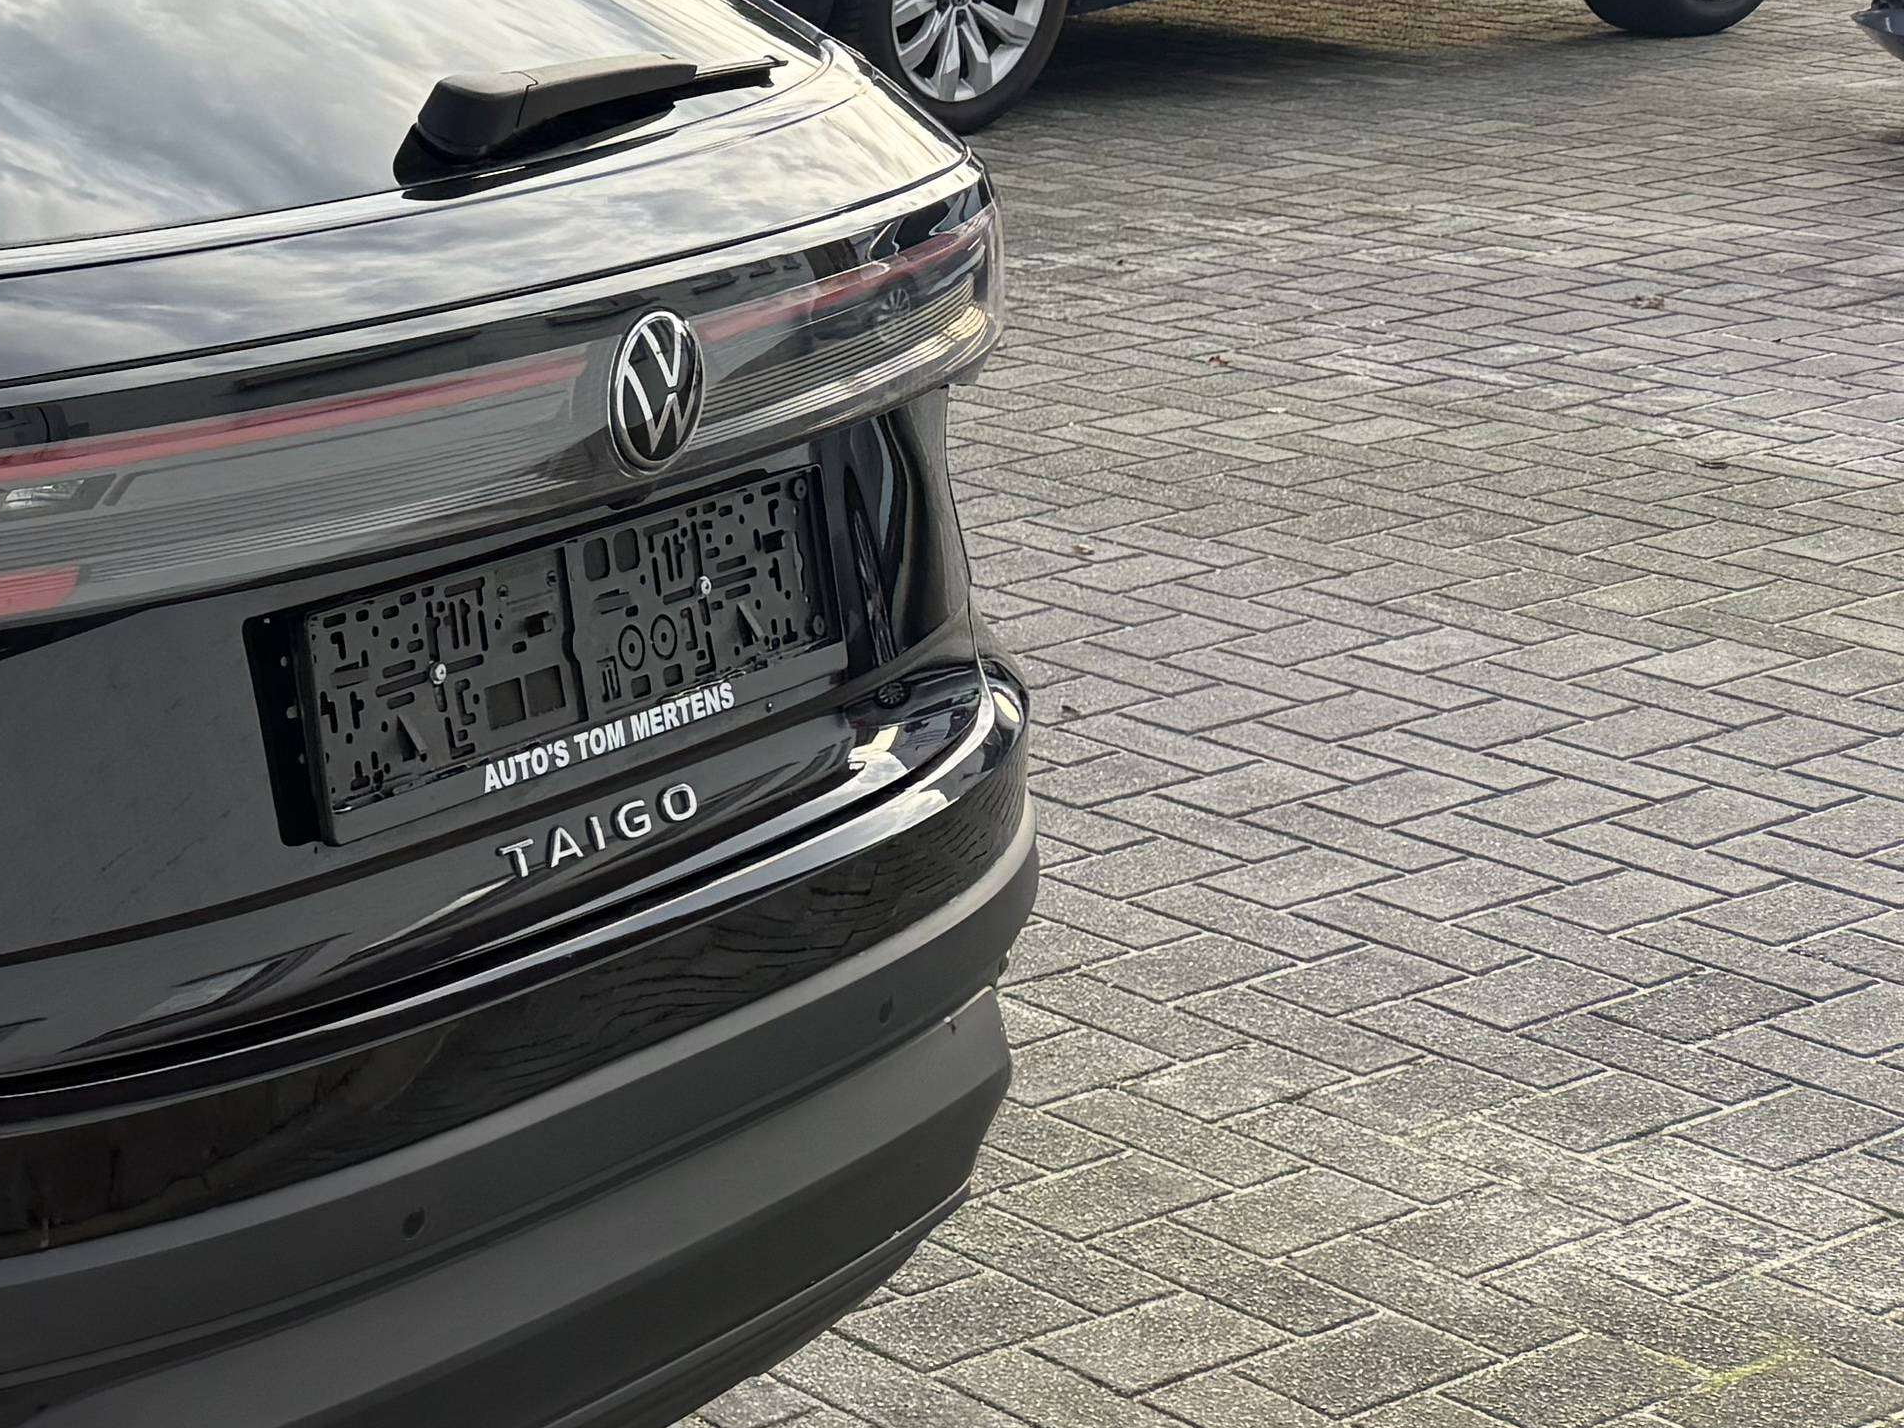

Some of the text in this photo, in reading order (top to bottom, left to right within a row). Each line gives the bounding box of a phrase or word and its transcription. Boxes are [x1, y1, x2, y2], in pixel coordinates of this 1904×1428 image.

[484, 682, 735, 793] AUTO'S TOM MERTENS
[496, 783, 698, 878] TAIGO
